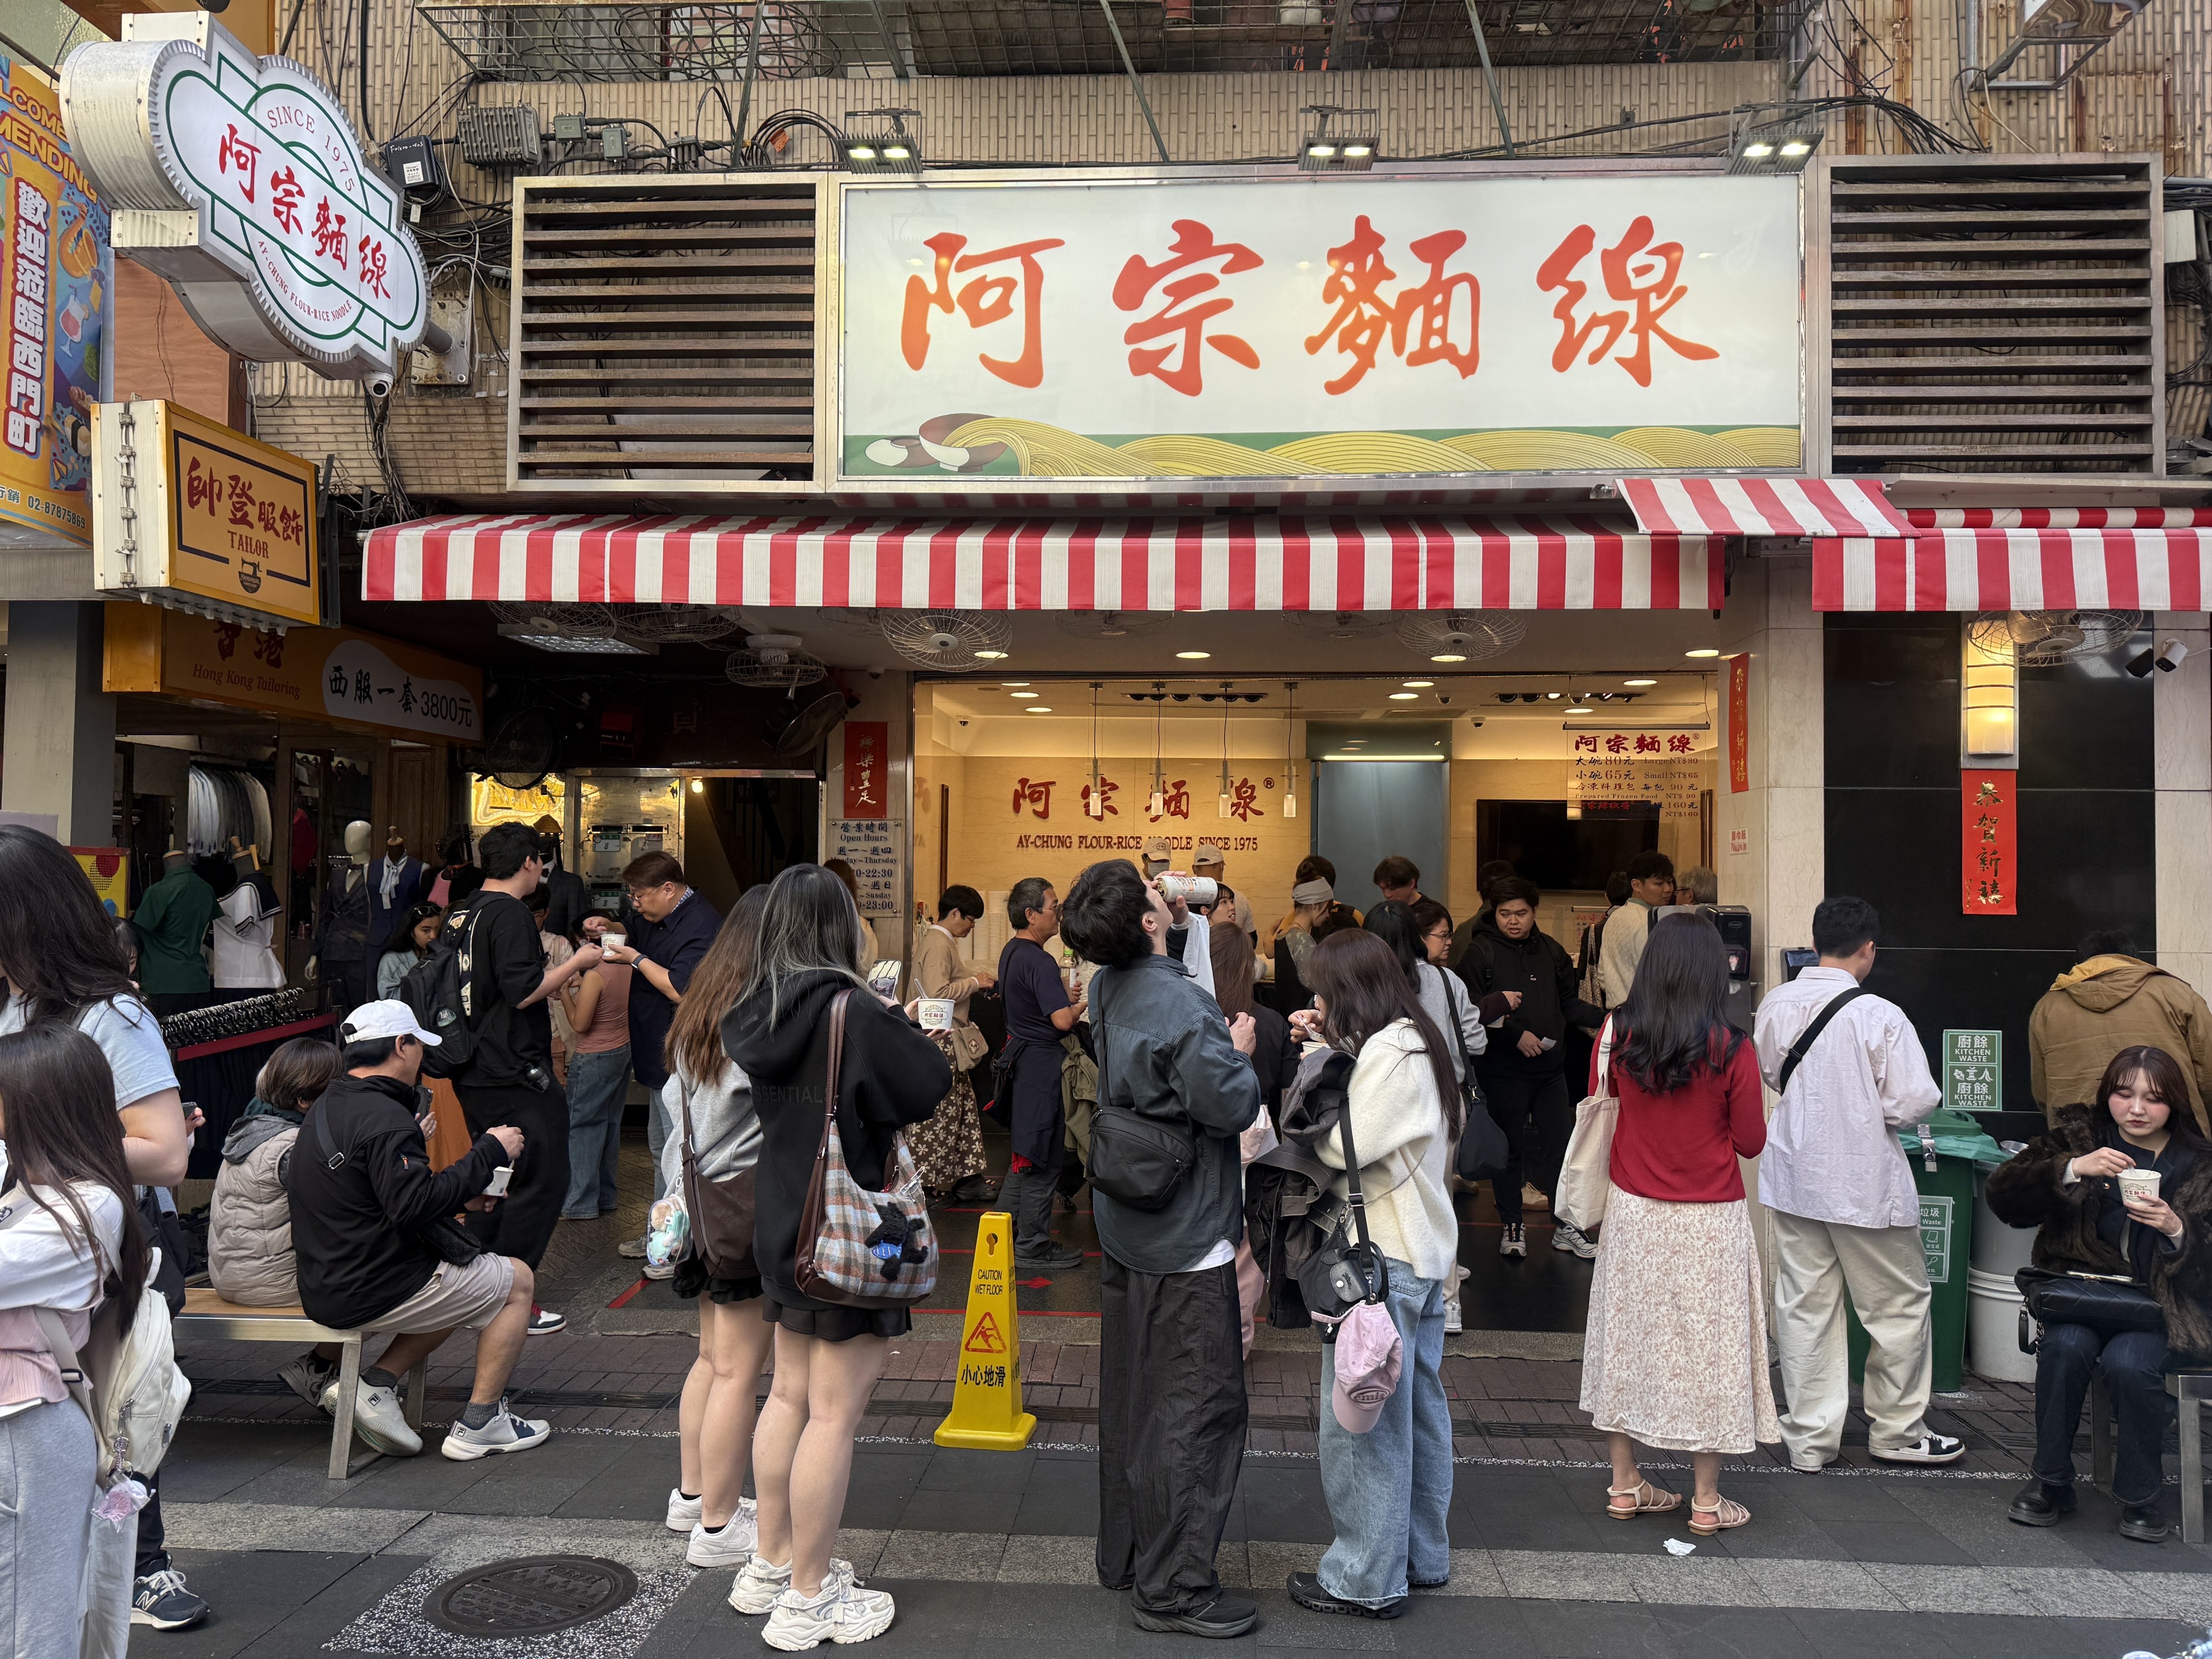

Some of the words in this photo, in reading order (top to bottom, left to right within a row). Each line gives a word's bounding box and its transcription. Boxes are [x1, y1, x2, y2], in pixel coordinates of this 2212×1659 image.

[267, 106, 315, 134] SINCE
[325, 135, 354, 191] 1975
[219, 123, 391, 299] 阿宗麵線
[258, 241, 288, 294] AY-CHUNG
[290, 292, 330, 321] FLOUR-RICE
[331, 300, 352, 321] NOODLE
[900, 214, 1720, 396] 阿宗麵線
[7, 181, 47, 453] 歡迎蒞臨西門町
[187, 456, 303, 546] 帥登服飾
[28, 495, 86, 529] 02-87875869
[228, 529, 269, 559] TAILOR
[192, 664, 223, 685] Hong
[226, 670, 253, 691] Kong
[257, 675, 300, 699] Tailoring
[1575, 733, 1695, 754] 阿宗麵線
[1580, 801, 1630, 810] 宗辣椒醬
[840, 821, 888, 833] 營業時間
[840, 834, 861, 843] Open
[1017, 835, 1073, 849] AY-CHUNG
[1078, 835, 1142, 850] FLOUR-RICE
[1149, 836, 1193, 850] ODLE
[1234, 836, 1257, 851] 1975
[1731, 842, 1747, 851] Napkin
[1973, 780, 2005, 906] 恭賀新禧
[1957, 1035, 1988, 1048] 廚餘
[755, 1085, 826, 1104] SSENTIAL
[1957, 1082, 1988, 1094] 廚餘
[1920, 1207, 1940, 1217] 垃圾
[978, 1269, 1002, 1280] CAUTION
[975, 1284, 986, 1294] WET
[987, 1284, 1003, 1295] FLOOR
[961, 1363, 1006, 1387] 小心地滑
[1354, 1392, 1385, 1400] emis
